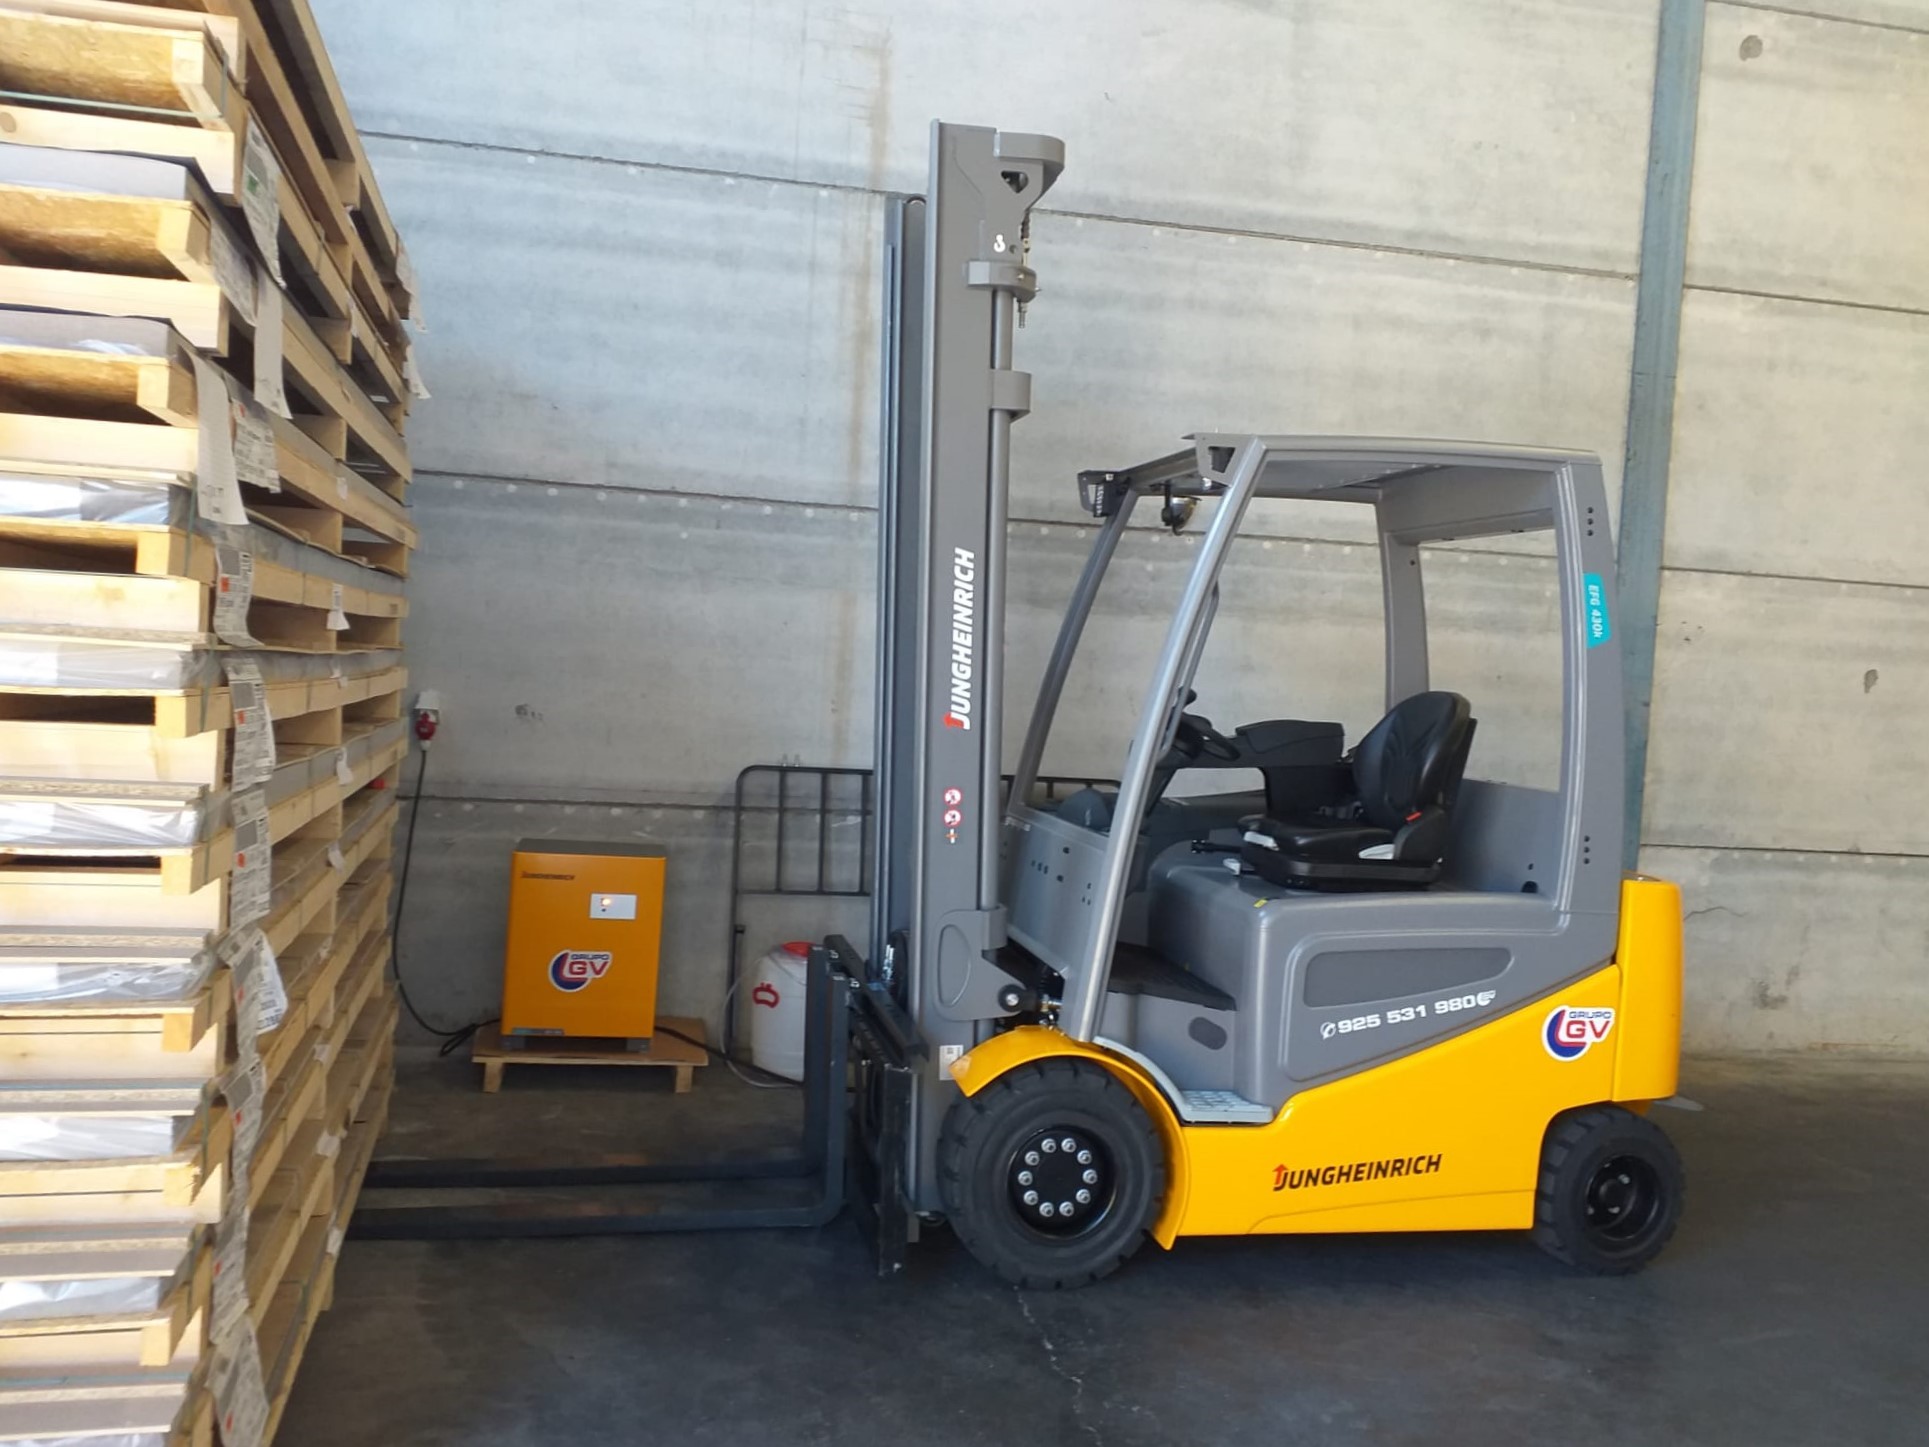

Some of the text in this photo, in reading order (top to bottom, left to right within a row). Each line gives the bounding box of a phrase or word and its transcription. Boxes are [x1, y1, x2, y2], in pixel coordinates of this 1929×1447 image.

[1588, 584, 1601, 606] EFG
[944, 547, 975, 731] JUNGHEINRICH
[568, 961, 609, 975] GV
[1337, 993, 1477, 1035] 925 531 980
[1568, 1010, 1612, 1020] GRUPO
[1566, 1020, 1611, 1039] GV
[1272, 1152, 1443, 1192] JUNGHEINRICH
